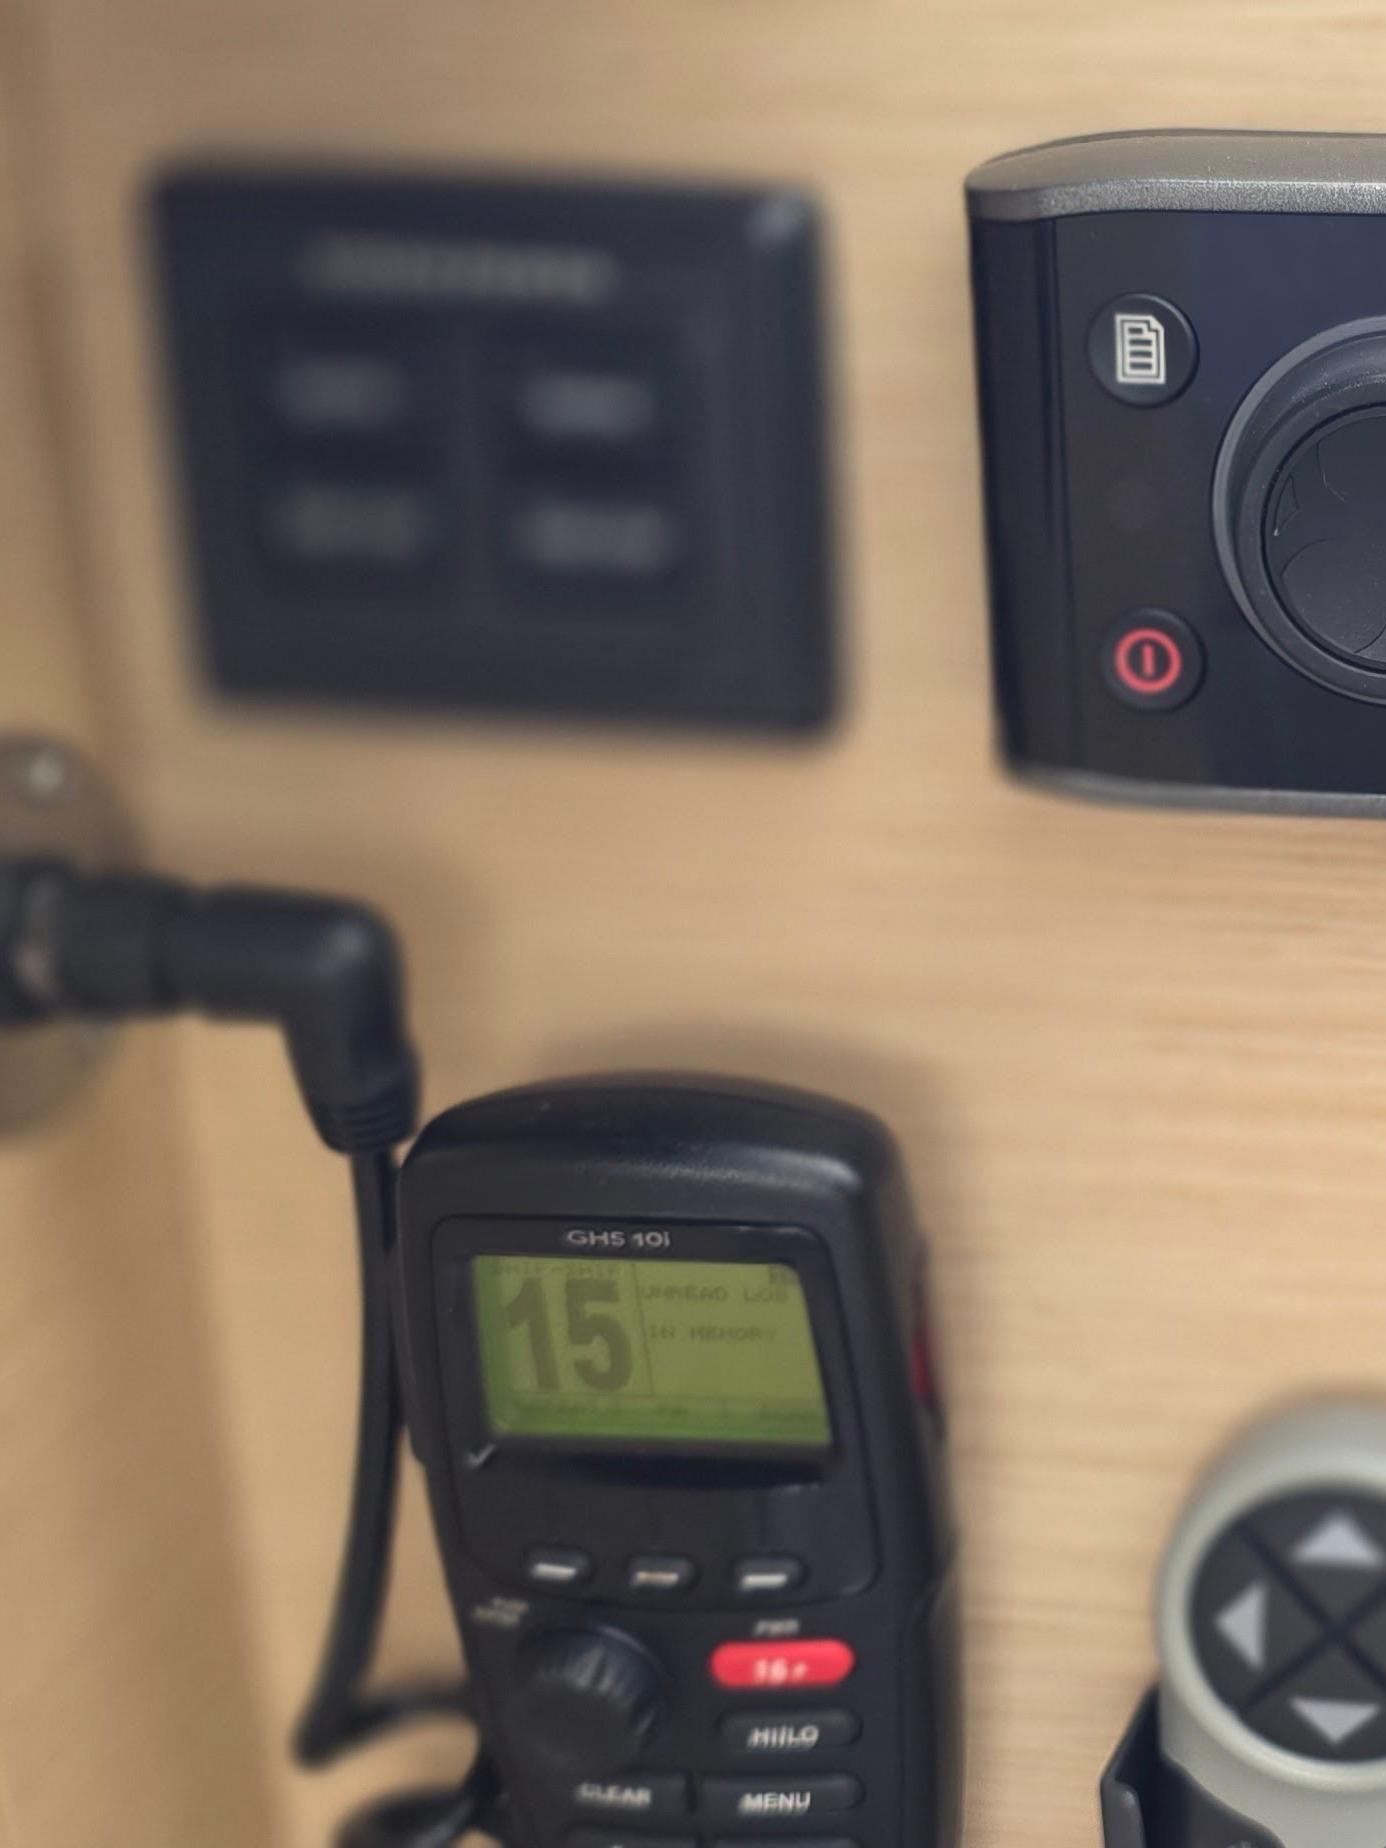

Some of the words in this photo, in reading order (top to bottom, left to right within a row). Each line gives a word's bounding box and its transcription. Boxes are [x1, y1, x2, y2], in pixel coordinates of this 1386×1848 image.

[565, 1229, 625, 1247] GHS
[631, 1231, 671, 1249] 10i
[506, 1276, 634, 1392] 15
[738, 1792, 812, 1814] MENU
